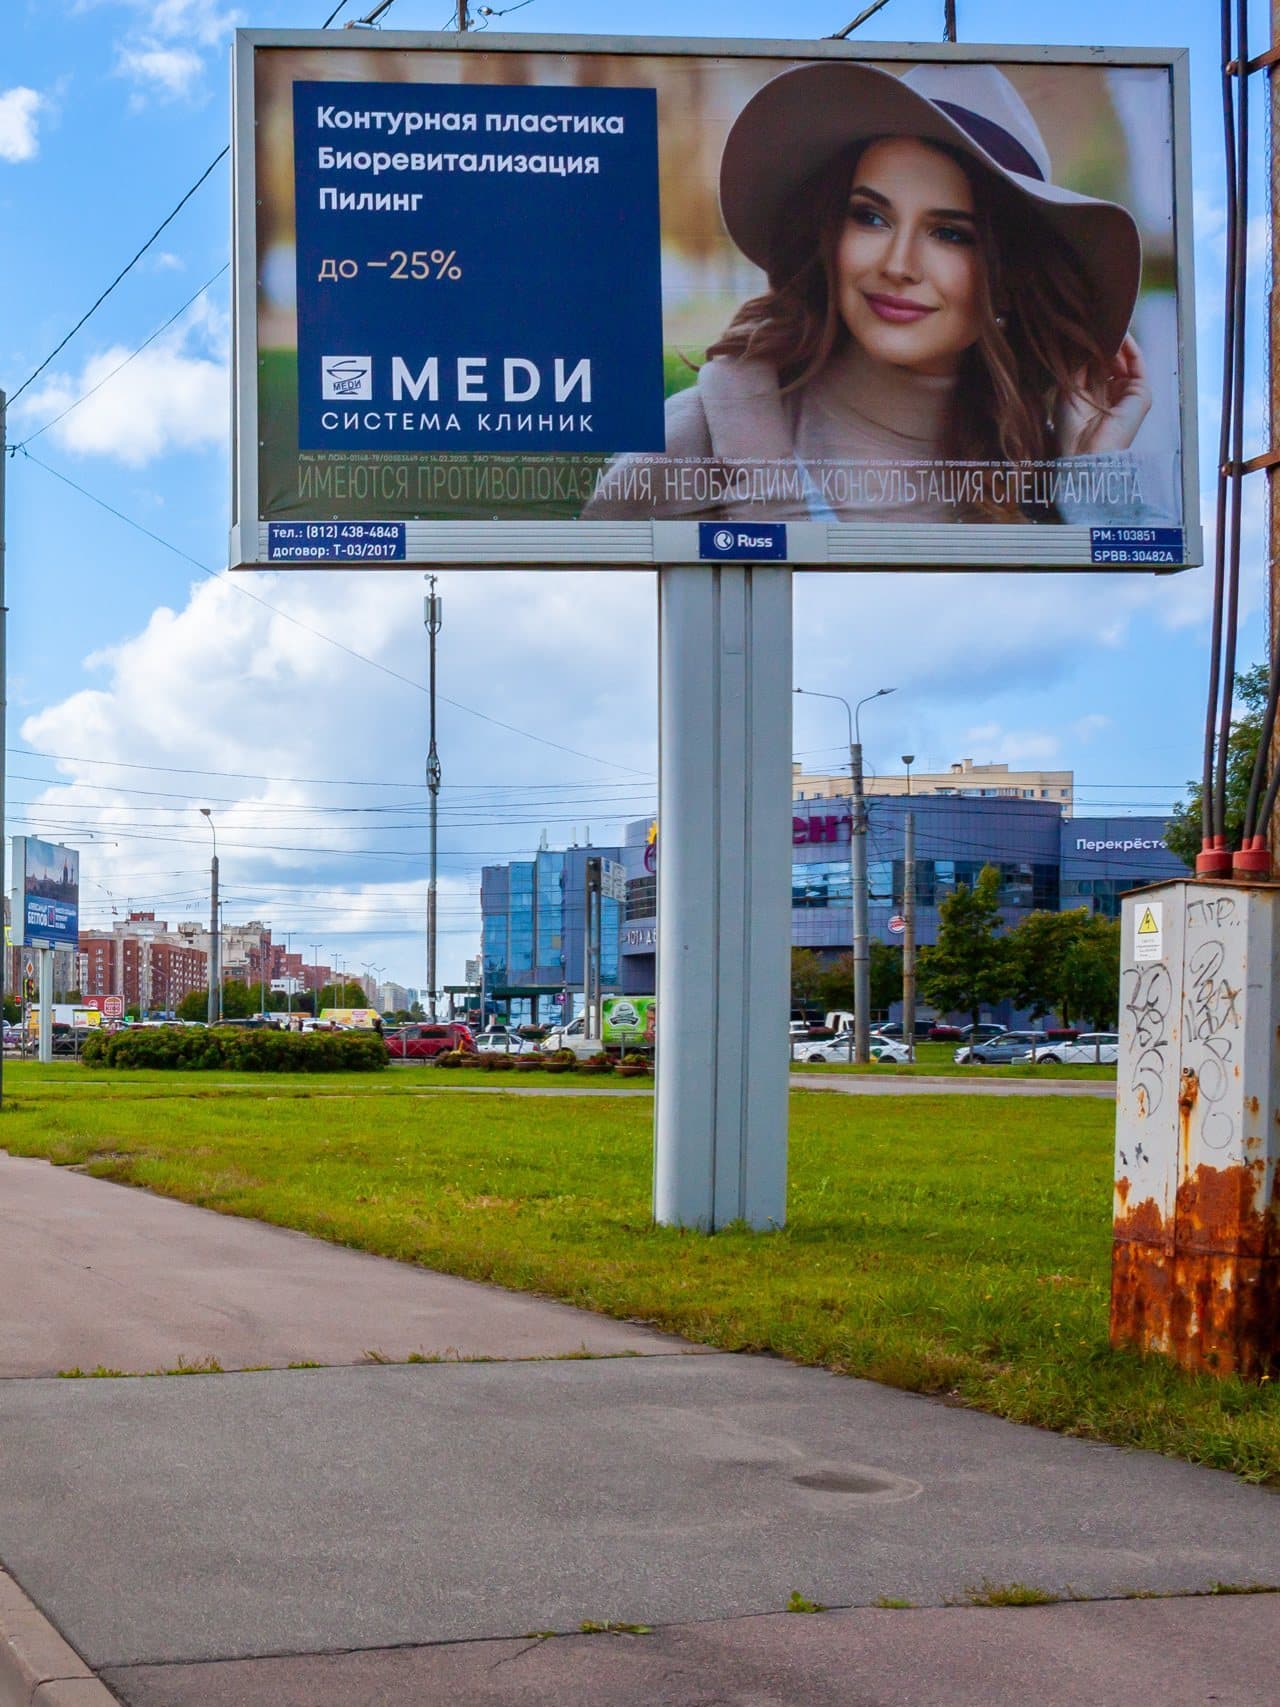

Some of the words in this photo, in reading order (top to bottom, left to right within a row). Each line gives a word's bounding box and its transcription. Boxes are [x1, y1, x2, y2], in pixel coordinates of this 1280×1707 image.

[317, 106, 477, 135] Контурная
[486, 113, 624, 134] пластика
[318, 147, 600, 176] Биоревитализация
[319, 187, 423, 211] Пилинг
[318, 260, 358, 282] до
[321, 412, 462, 431] СИСТЕМА
[477, 414, 594, 432] КЛИНИК
[298, 465, 409, 499] ИМЕЮТСЯ
[417, 466, 656, 506] ПРОТИВОПОКАЗАНИЯ,
[821, 470, 984, 507] КОНСУЛЬТАЦИЯ
[992, 471, 1144, 508] СПЕЦИАЛИСТА
[273, 528, 303, 538] тел.:
[306, 525, 338, 539] (812)
[341, 526, 399, 538] 438-4848
[737, 534, 773, 548] Russ
[272, 547, 330, 559] договор:
[333, 544, 397, 557] Т-03/2017
[1094, 550, 1174, 562] SPBB:30482A
